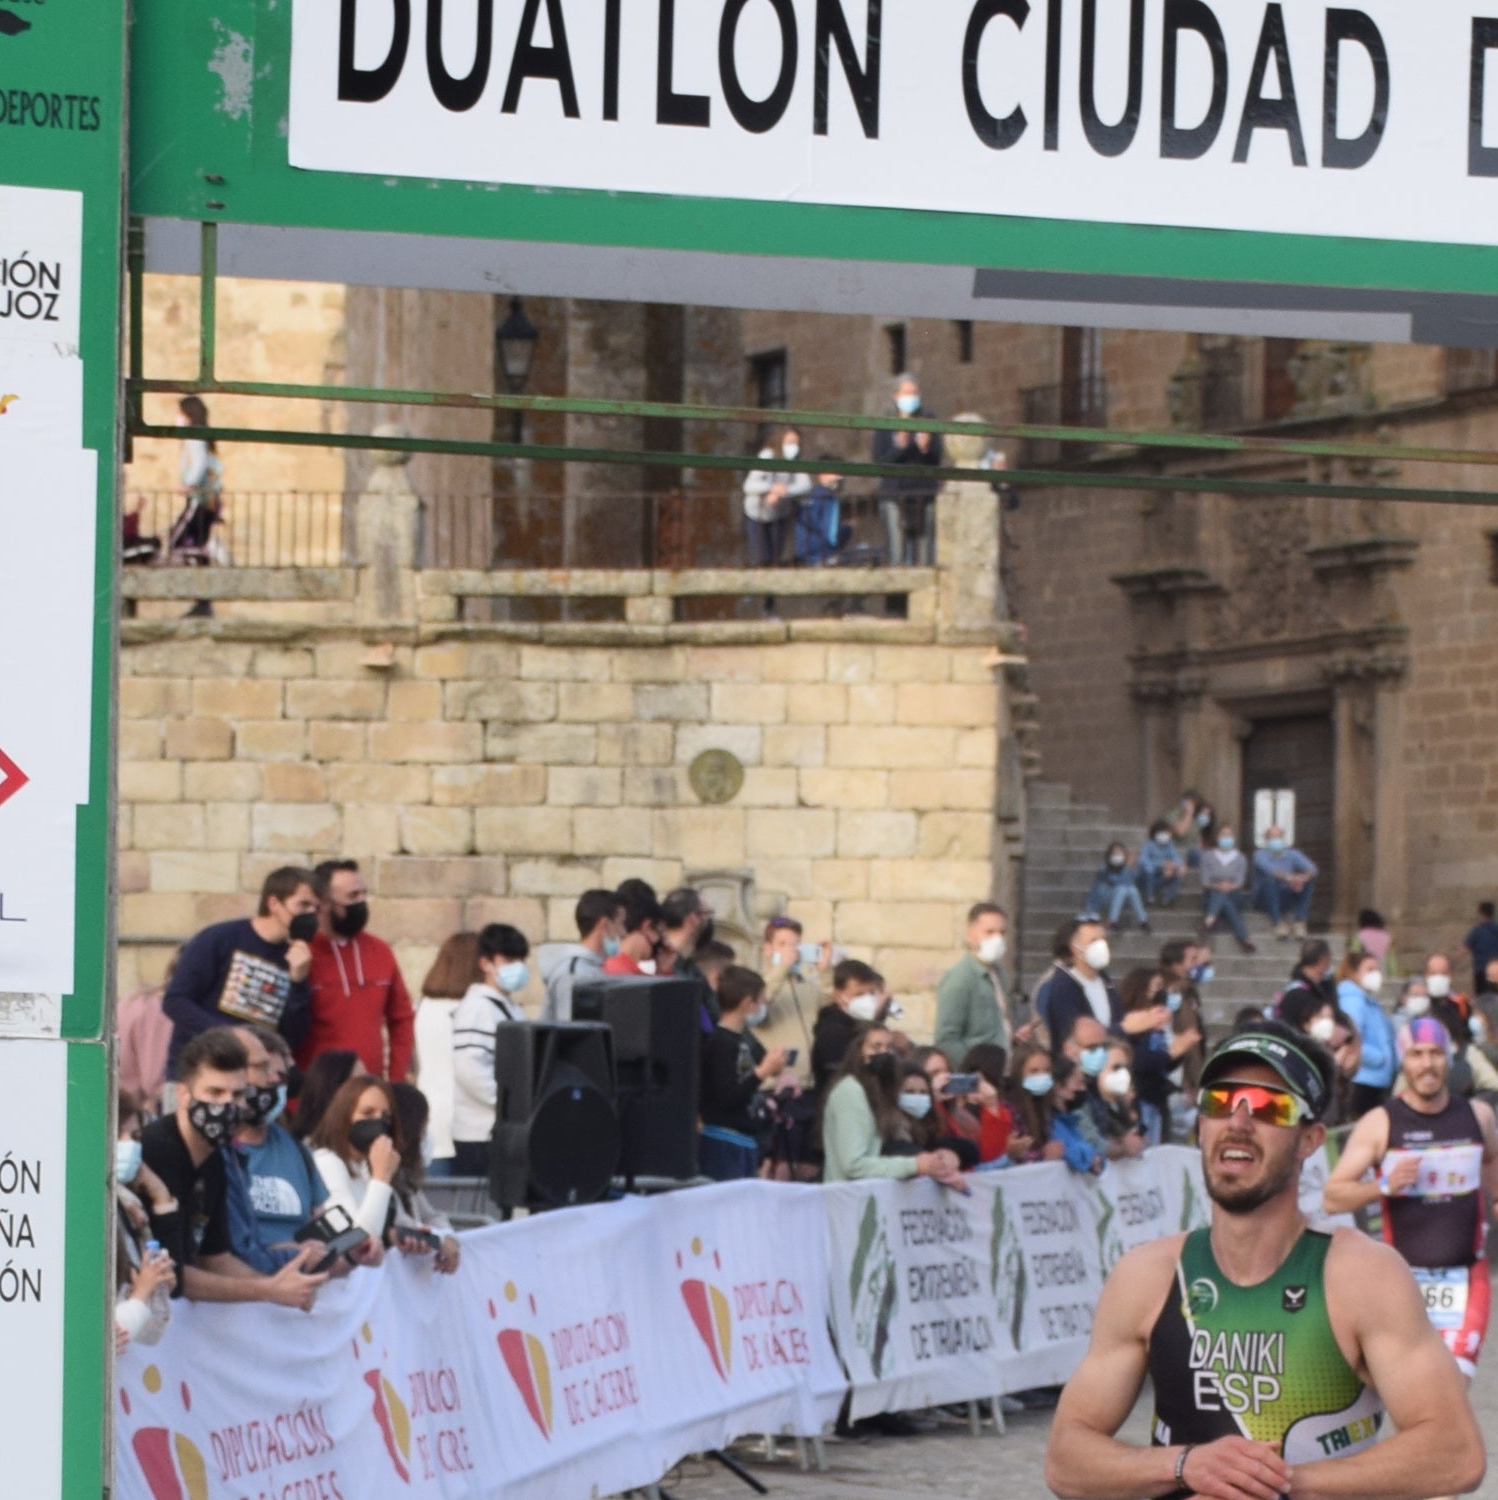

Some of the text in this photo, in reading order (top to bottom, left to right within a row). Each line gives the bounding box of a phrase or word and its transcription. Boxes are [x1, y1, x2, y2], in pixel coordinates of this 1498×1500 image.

[962, 0, 1390, 169] CIUDAD
[1189, 1329, 1285, 1375] DANIKI
[1193, 1371, 1282, 1415] ESP
[210, 1398, 335, 1482] DIPUTACIÓN
